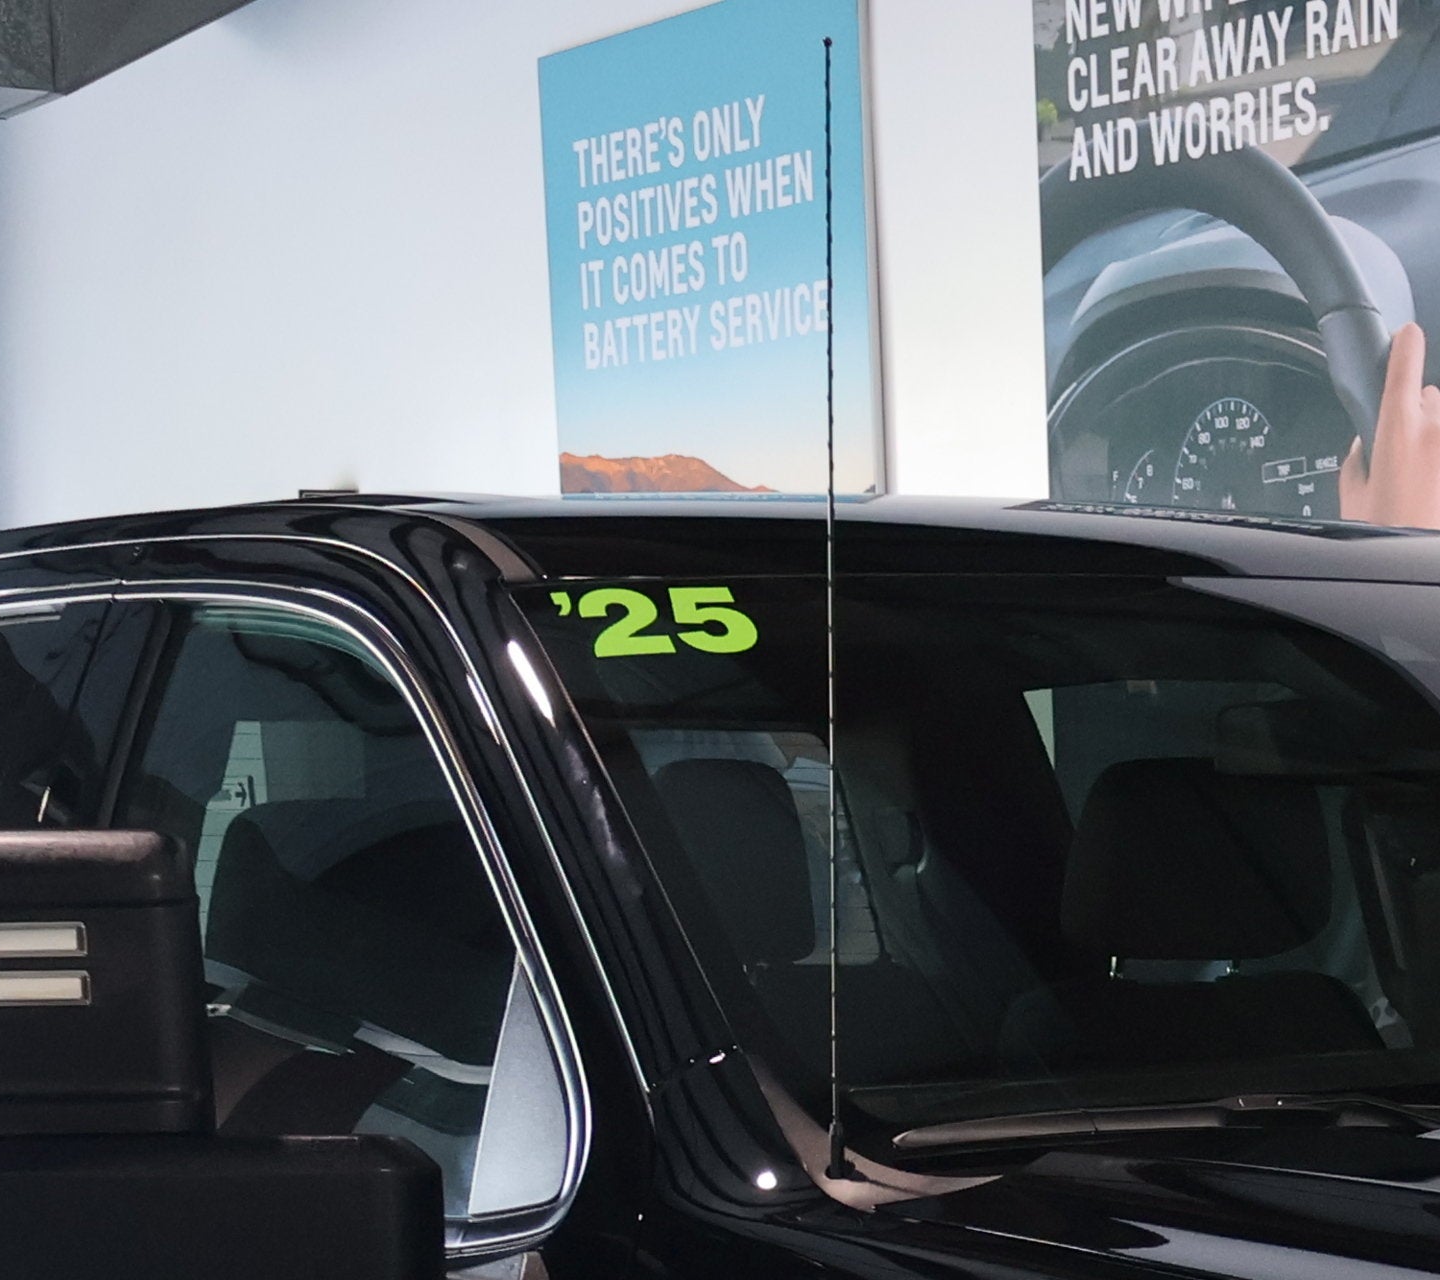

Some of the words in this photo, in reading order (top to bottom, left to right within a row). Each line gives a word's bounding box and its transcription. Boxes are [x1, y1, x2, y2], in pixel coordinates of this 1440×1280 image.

[1065, 0, 1141, 43] NEW
[1068, 37, 1178, 112] CLEAR
[1189, 6, 1294, 87] AWAY
[1305, 0, 1398, 59] RAIN
[572, 116, 685, 188] THERE'S
[693, 94, 765, 162] ONLY
[1069, 116, 1139, 182] AND
[1149, 77, 1330, 166] WORRIES.
[577, 174, 718, 250] POSITIVES
[725, 150, 814, 218] WHEN
[580, 259, 605, 311] IT
[612, 240, 706, 305] COMES
[712, 231, 748, 285] TO
[584, 304, 702, 370] BATTERY
[1214, 416, 1229, 430] 100
[1235, 417, 1251, 430] 120
[1249, 435, 1265, 448] 140
